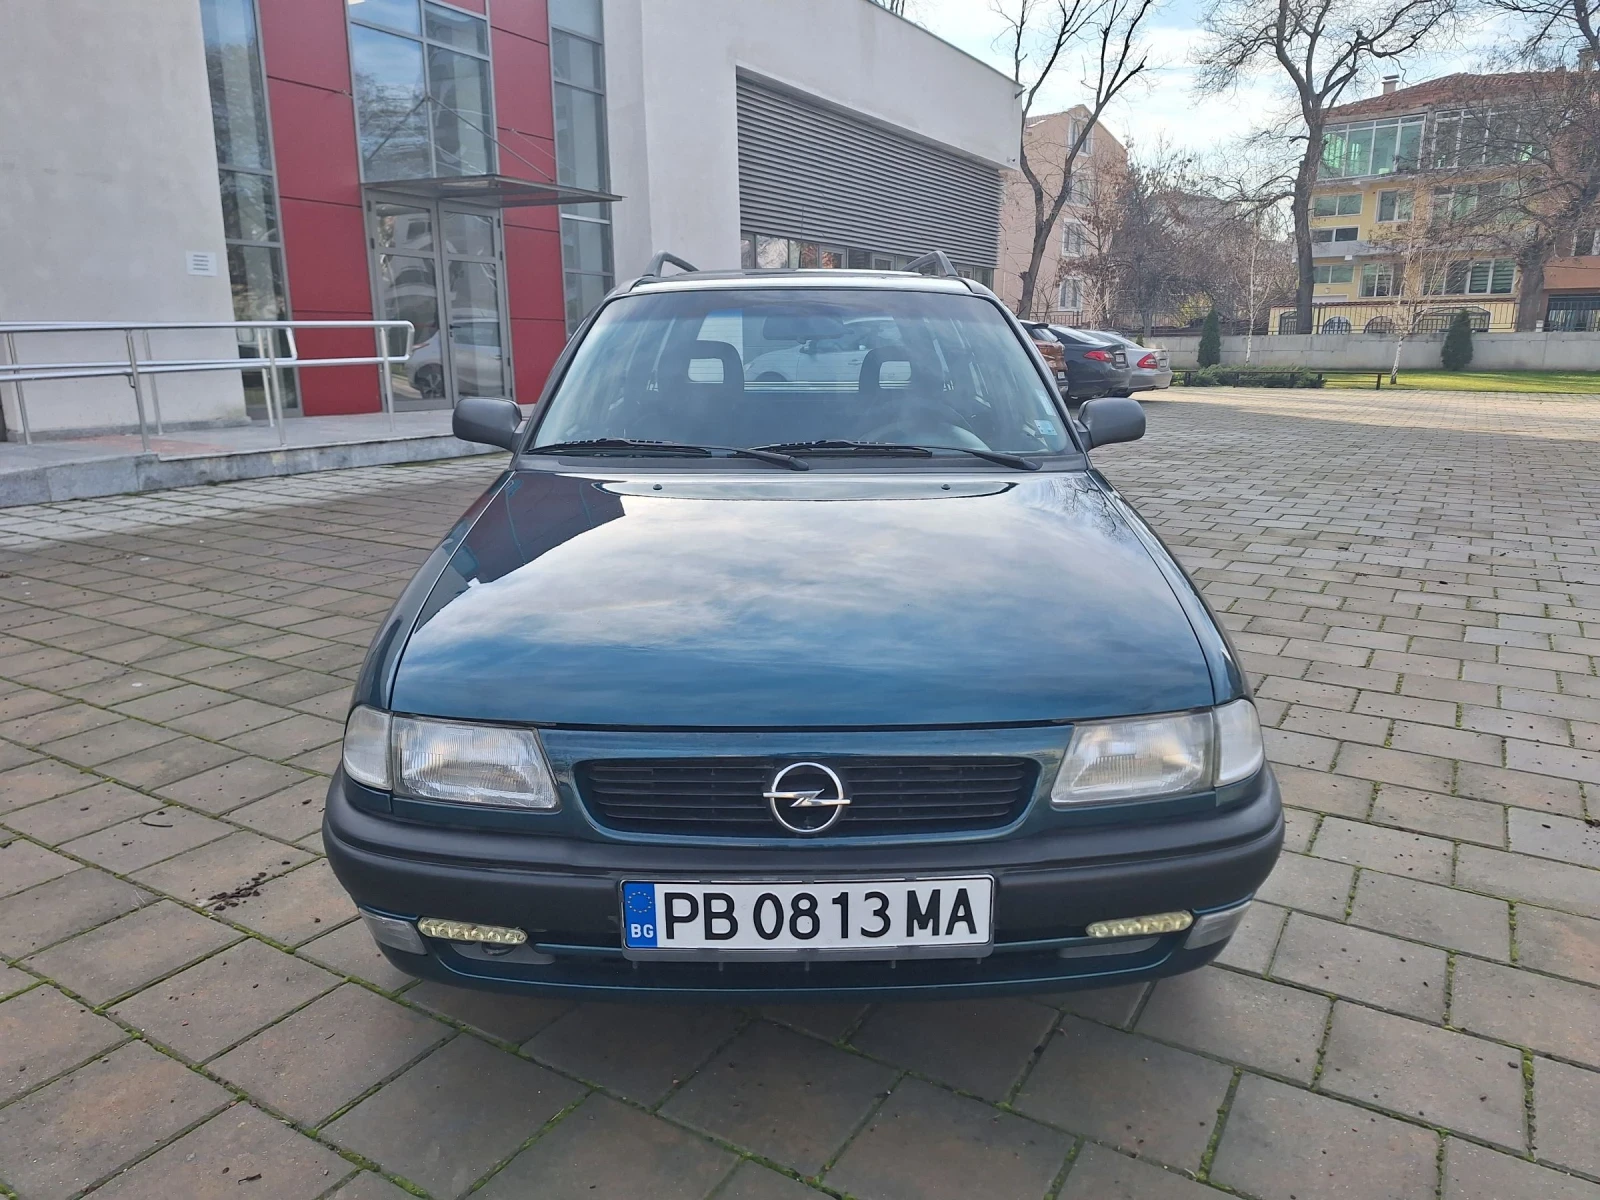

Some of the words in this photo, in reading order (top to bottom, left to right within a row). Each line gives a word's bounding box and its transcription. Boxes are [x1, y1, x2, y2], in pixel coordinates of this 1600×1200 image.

[664, 892, 739, 940] PB
[753, 891, 892, 940] 0813
[906, 888, 977, 937] MA
[631, 924, 654, 939] BG
